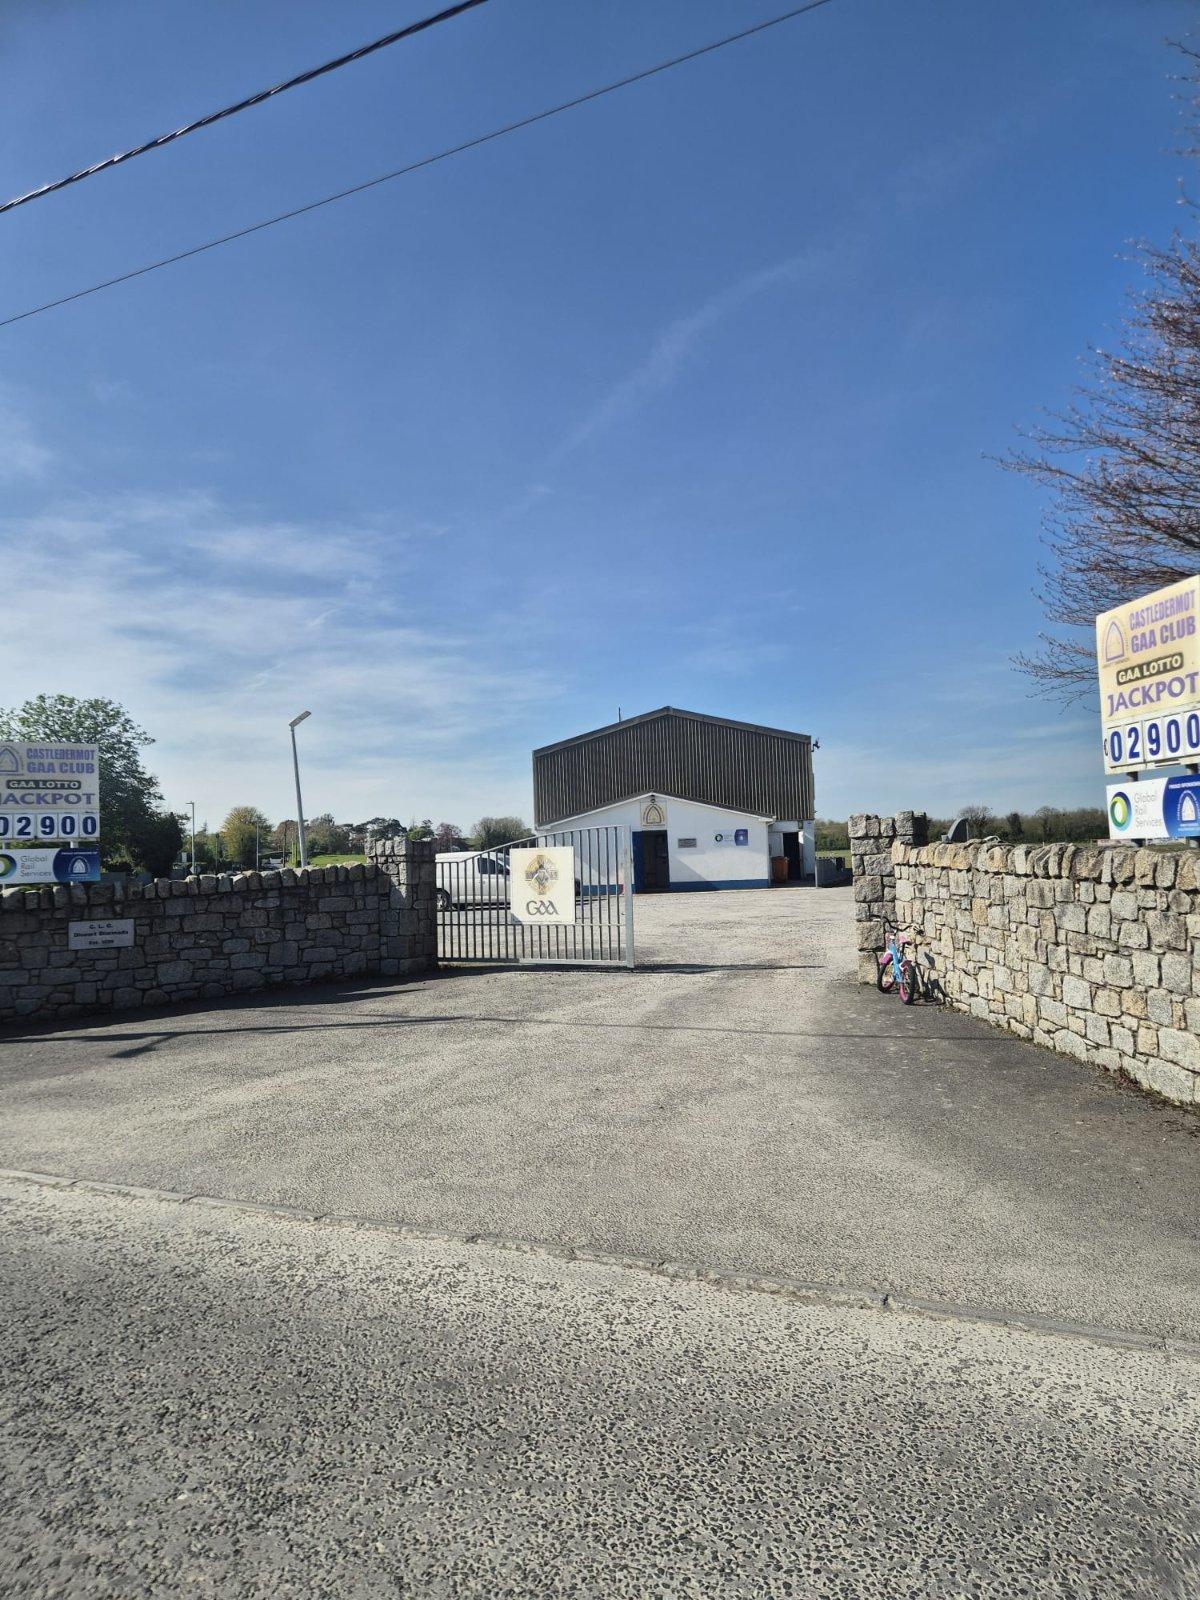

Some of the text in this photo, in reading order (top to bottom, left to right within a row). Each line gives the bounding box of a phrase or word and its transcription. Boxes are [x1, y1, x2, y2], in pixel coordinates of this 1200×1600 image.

[1129, 590, 1195, 631] CASTLEDERMOT
[1131, 616, 1196, 653] GAA CLUB
[1118, 655, 1181, 683] GAA LOTTO
[1107, 672, 1199, 717] JACKPOT
[26, 748, 95, 760] CASTLEDERMOT
[27, 762, 95, 774] GAA CLUB
[9, 781, 79, 789] GAA LOTTO
[0, 793, 95, 805] ACKPOT
[20, 855, 48, 863] Global
[526, 900, 559, 915] GAA
